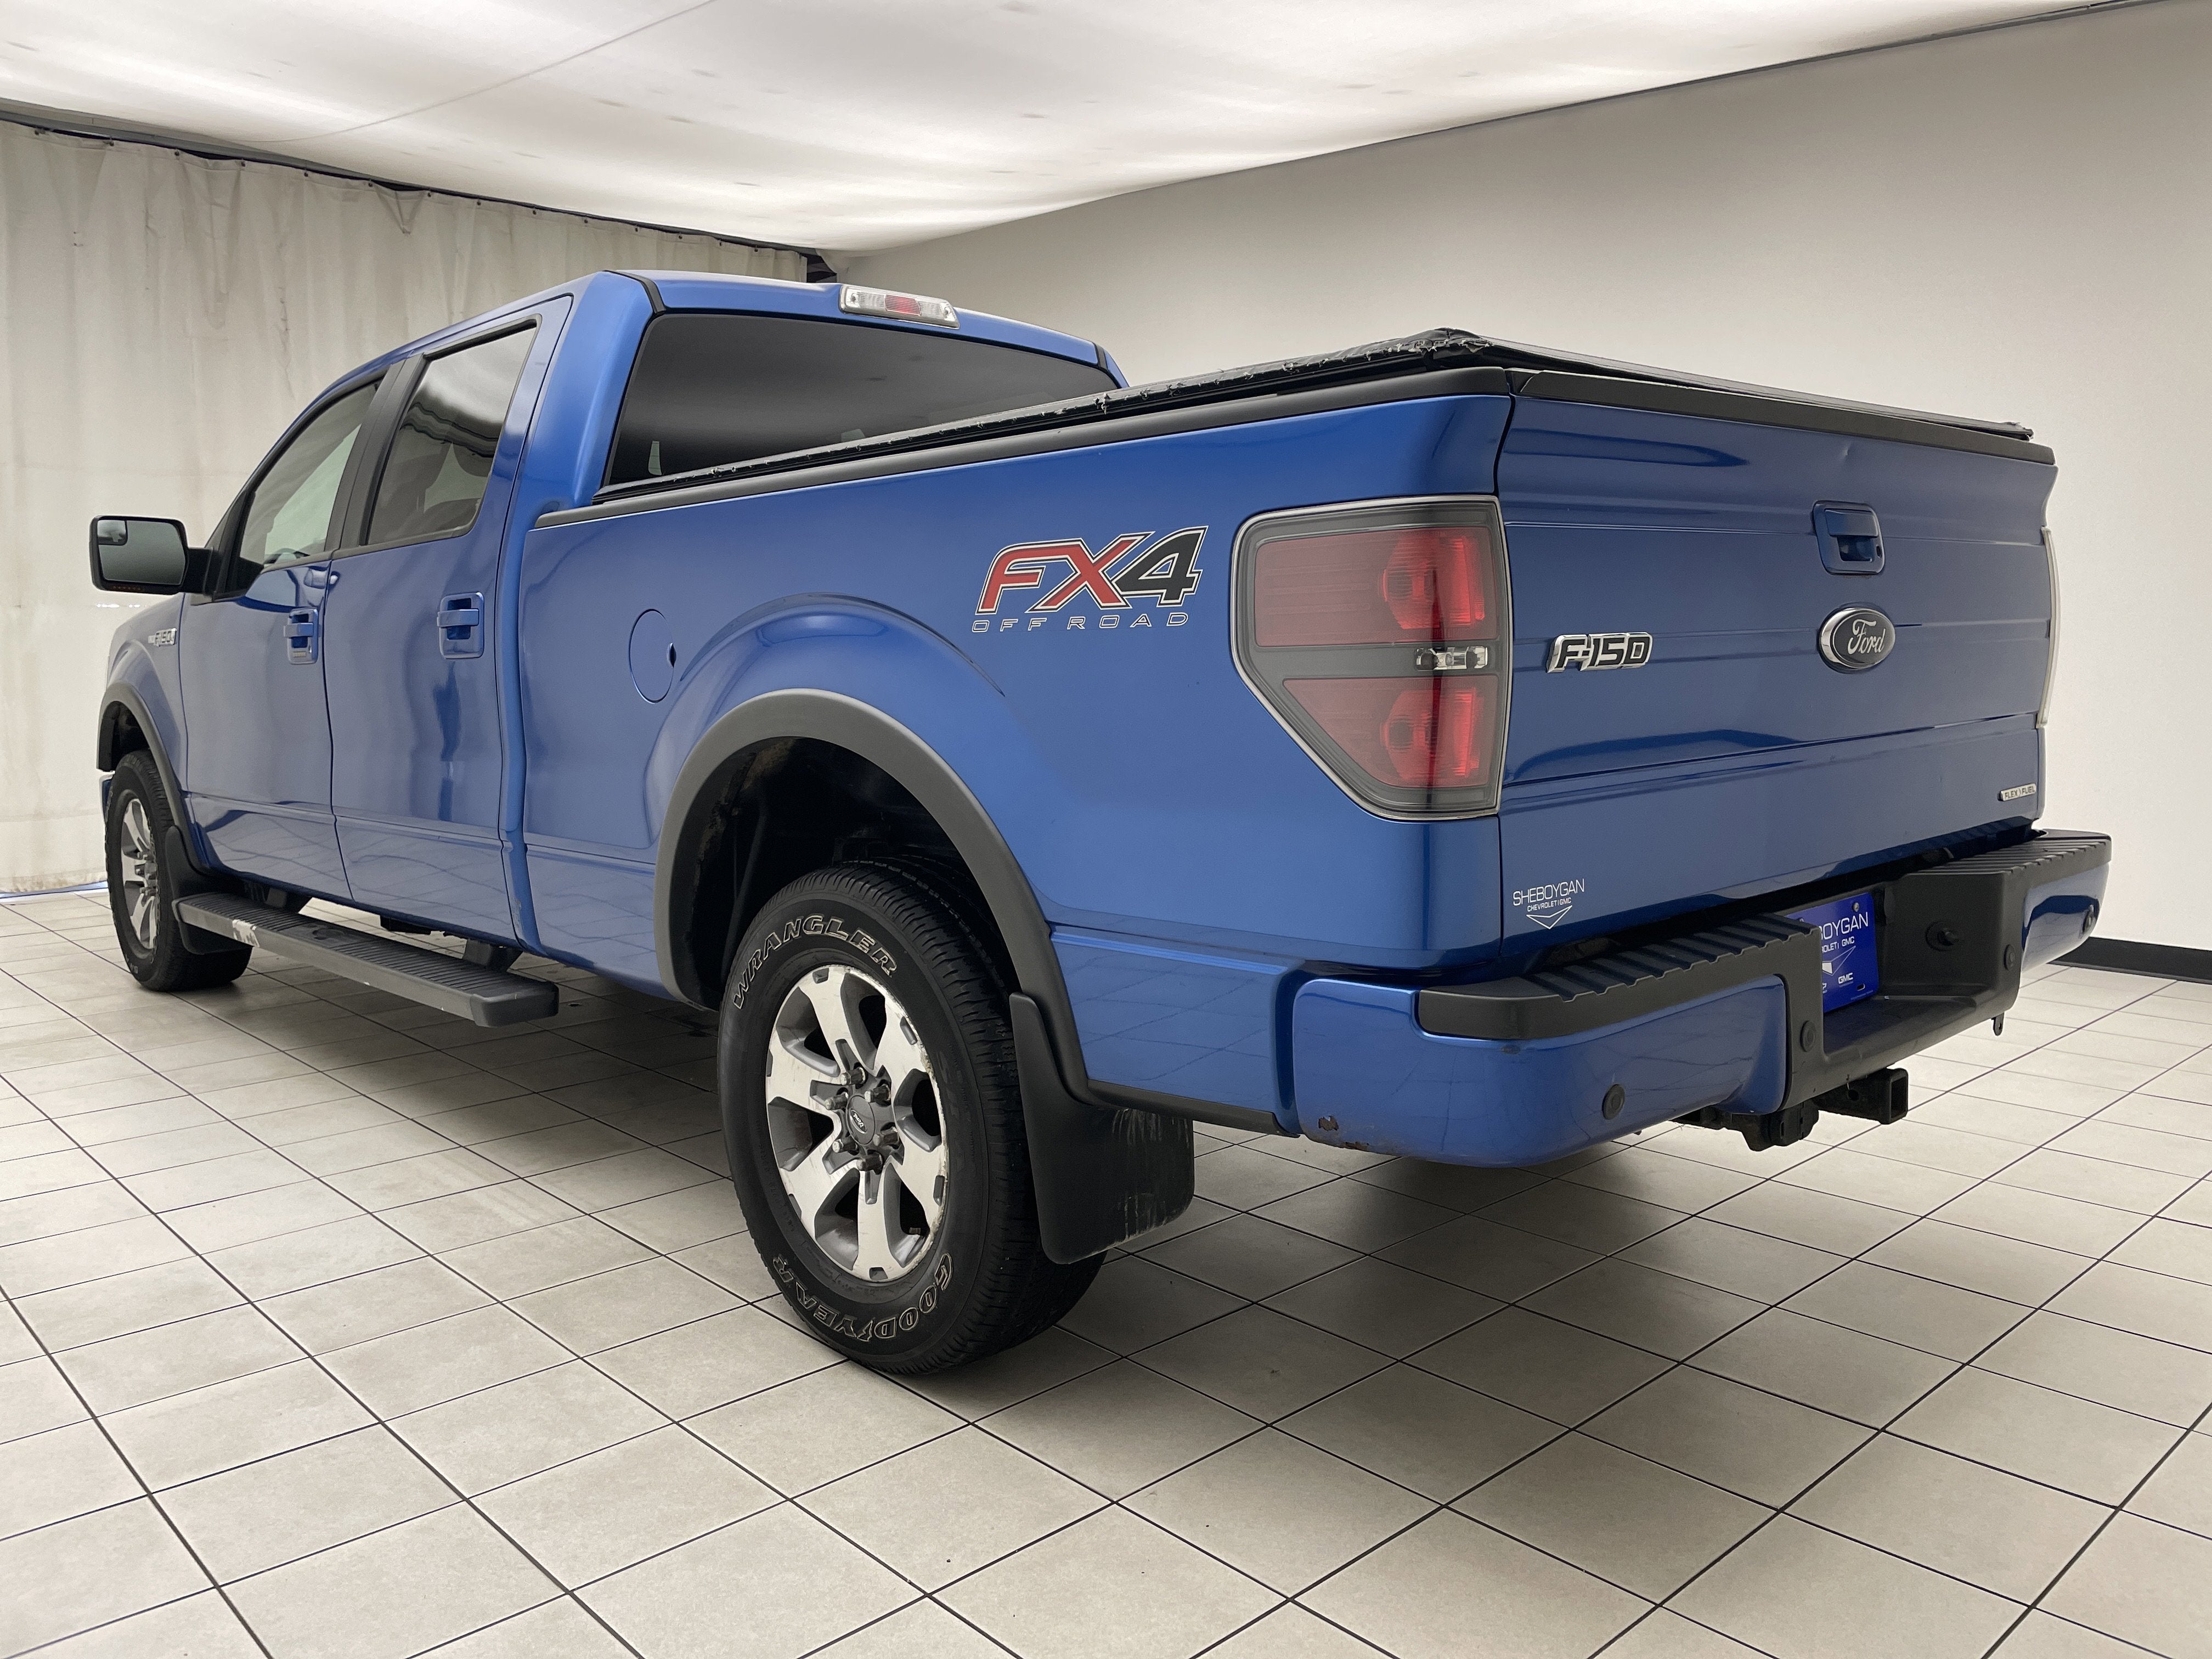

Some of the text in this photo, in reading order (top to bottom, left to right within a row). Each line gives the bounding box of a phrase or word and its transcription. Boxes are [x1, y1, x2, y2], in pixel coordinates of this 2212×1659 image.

[975, 525, 1209, 614] FX4
[972, 612, 1189, 633] OFF ROAD
[1847, 619, 1886, 655] Ford
[1549, 633, 1652, 672] F-150
[2005, 786, 2035, 799] FLEX FUEL
[1513, 878, 1585, 906] SHEBOYGAN
[1527, 900, 1558, 912] CHEVROLET
[1842, 936, 1854, 947] GMC
[732, 913, 898, 1010] WRANGLER
[1838, 973, 1853, 984] GMC
[772, 1252, 953, 1342] GOODYEAR
